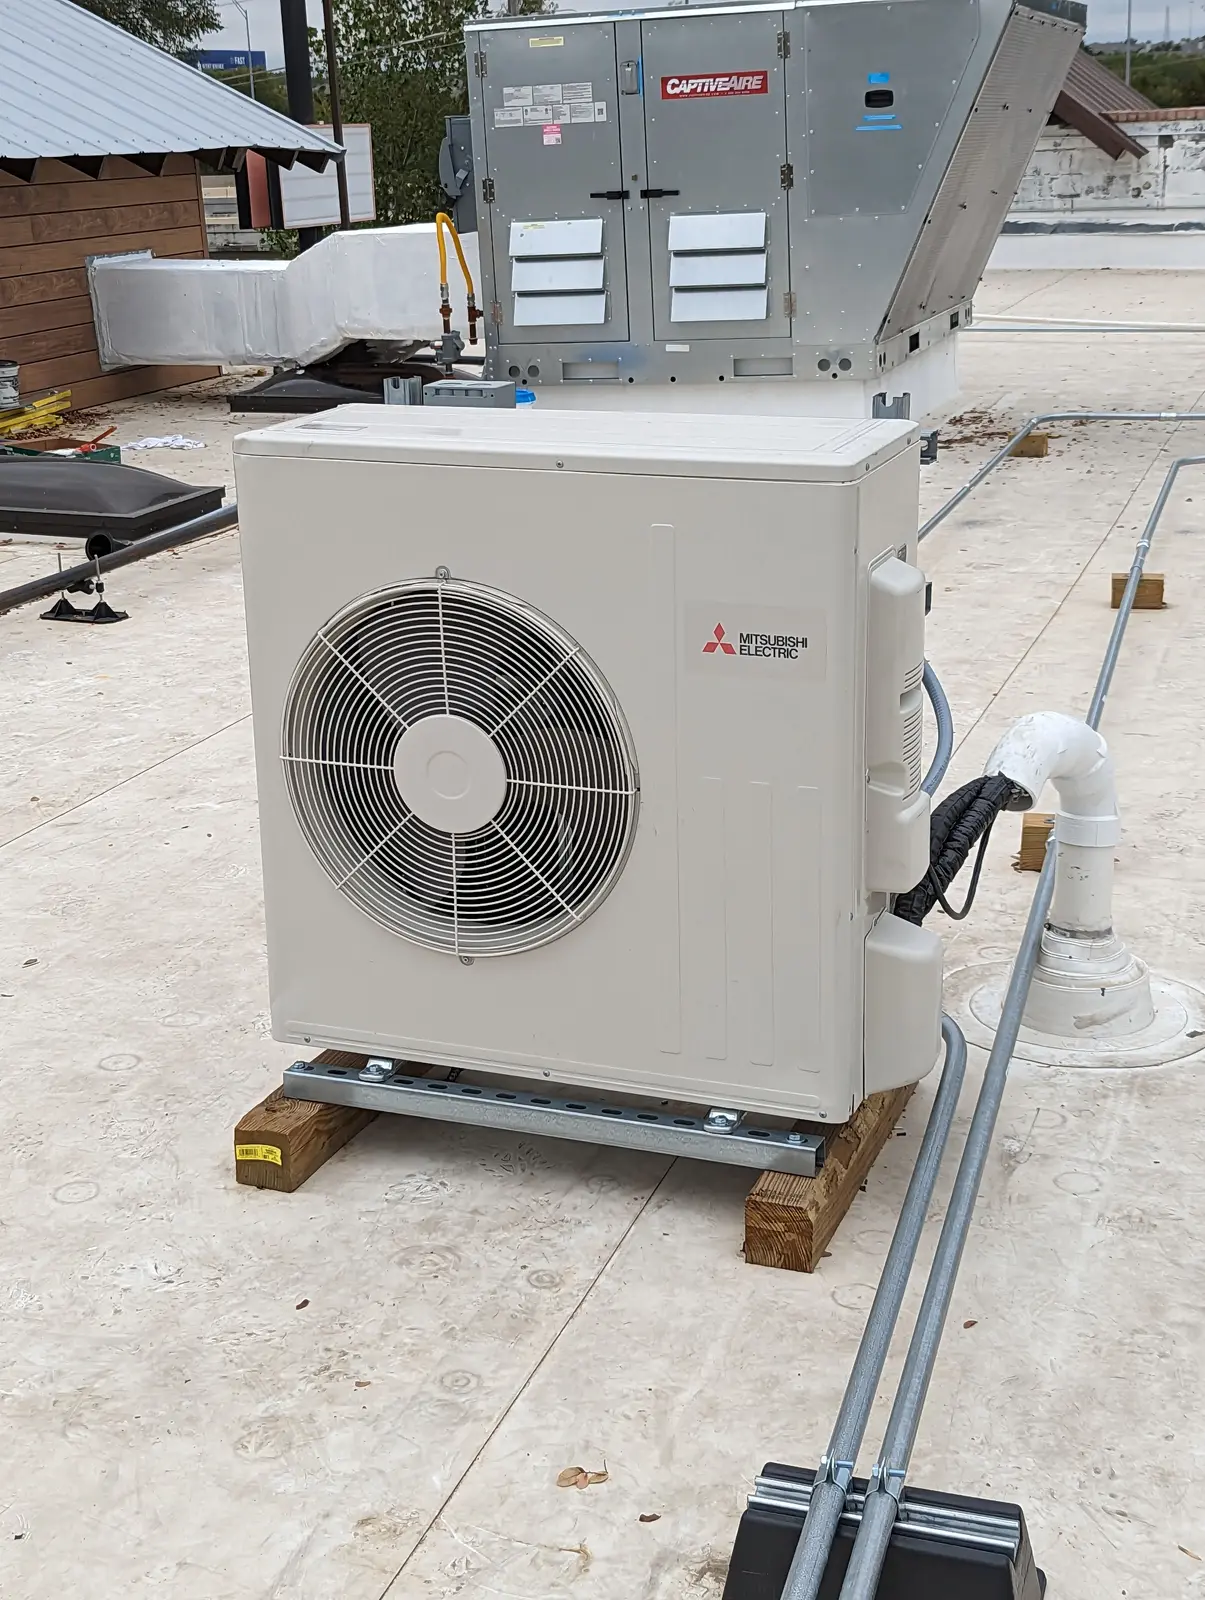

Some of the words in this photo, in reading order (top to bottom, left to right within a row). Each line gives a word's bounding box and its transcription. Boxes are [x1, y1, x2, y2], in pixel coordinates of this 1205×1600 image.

[234, 56, 246, 65] FAST
[666, 75, 764, 94] CAPTIVEAIRE
[739, 633, 808, 648] MITSUBISHI
[739, 645, 799, 659] ELECTRIC
